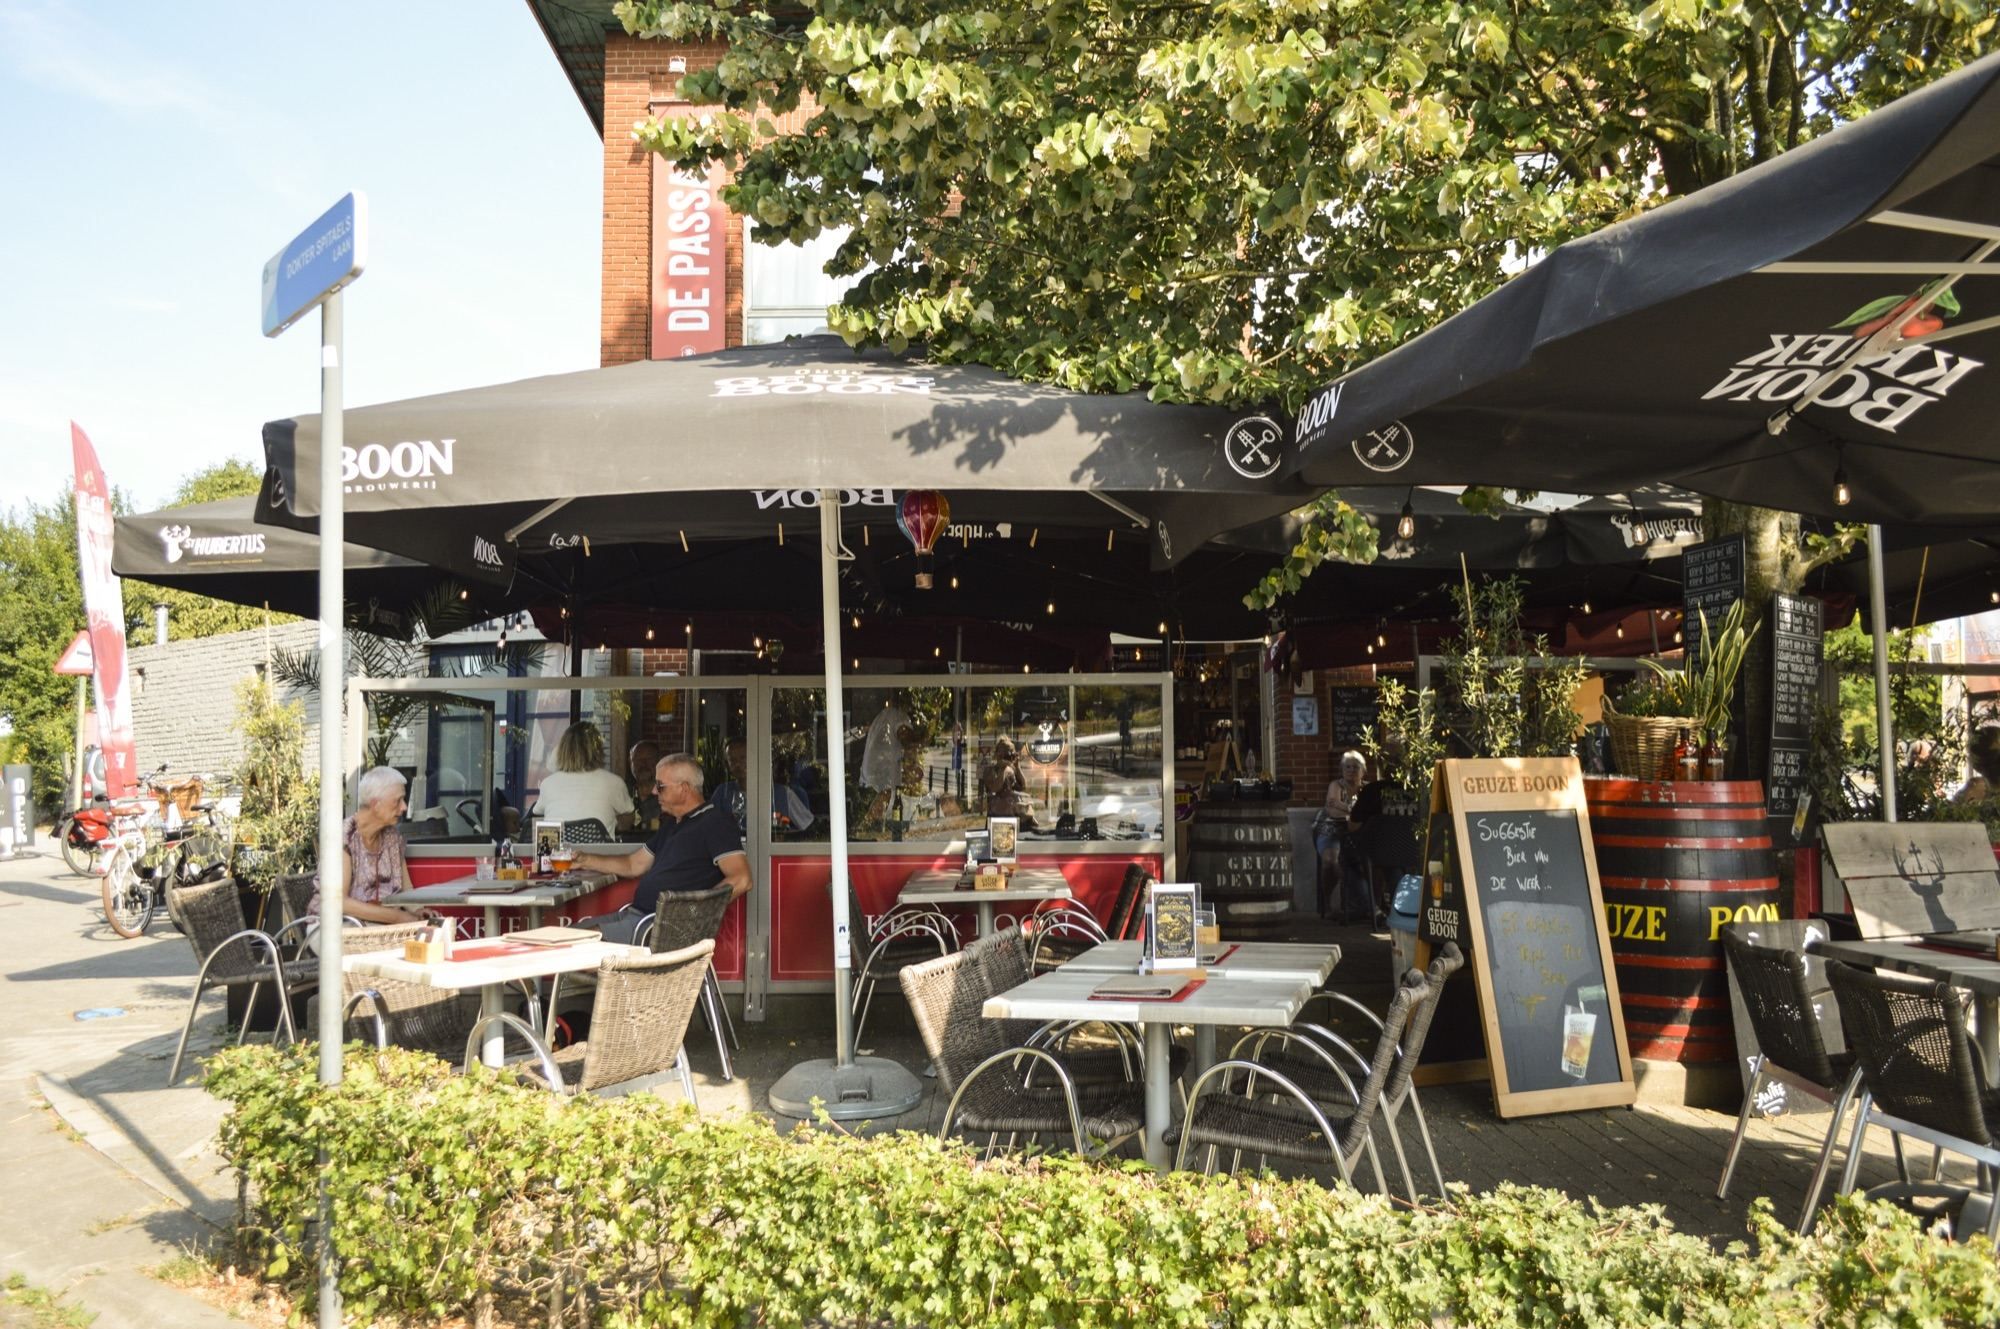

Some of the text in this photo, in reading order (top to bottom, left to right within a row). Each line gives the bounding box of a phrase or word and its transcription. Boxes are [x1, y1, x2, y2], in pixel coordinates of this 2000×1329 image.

[286, 215, 351, 279] DOKTER SPITAELS
[333, 239, 350, 262] LAAN
[668, 288, 710, 331] DE
[709, 383, 931, 397] BOON
[1296, 381, 1346, 443] BOON
[341, 439, 456, 481] BOON
[344, 480, 436, 493] BROUWERIJ
[1645, 517, 1703, 539] HUBERTU
[193, 533, 265, 555] HUBERTUS
[1464, 775, 1569, 795] GEUZE BOON
[1234, 827, 1284, 841] OUDE
[1228, 856, 1288, 870] GEUZE
[972, 913, 1073, 938] ON
[1427, 907, 1459, 925] GEUZE
[1603, 903, 1667, 941] UZE
[1429, 921, 1458, 939] BOON
